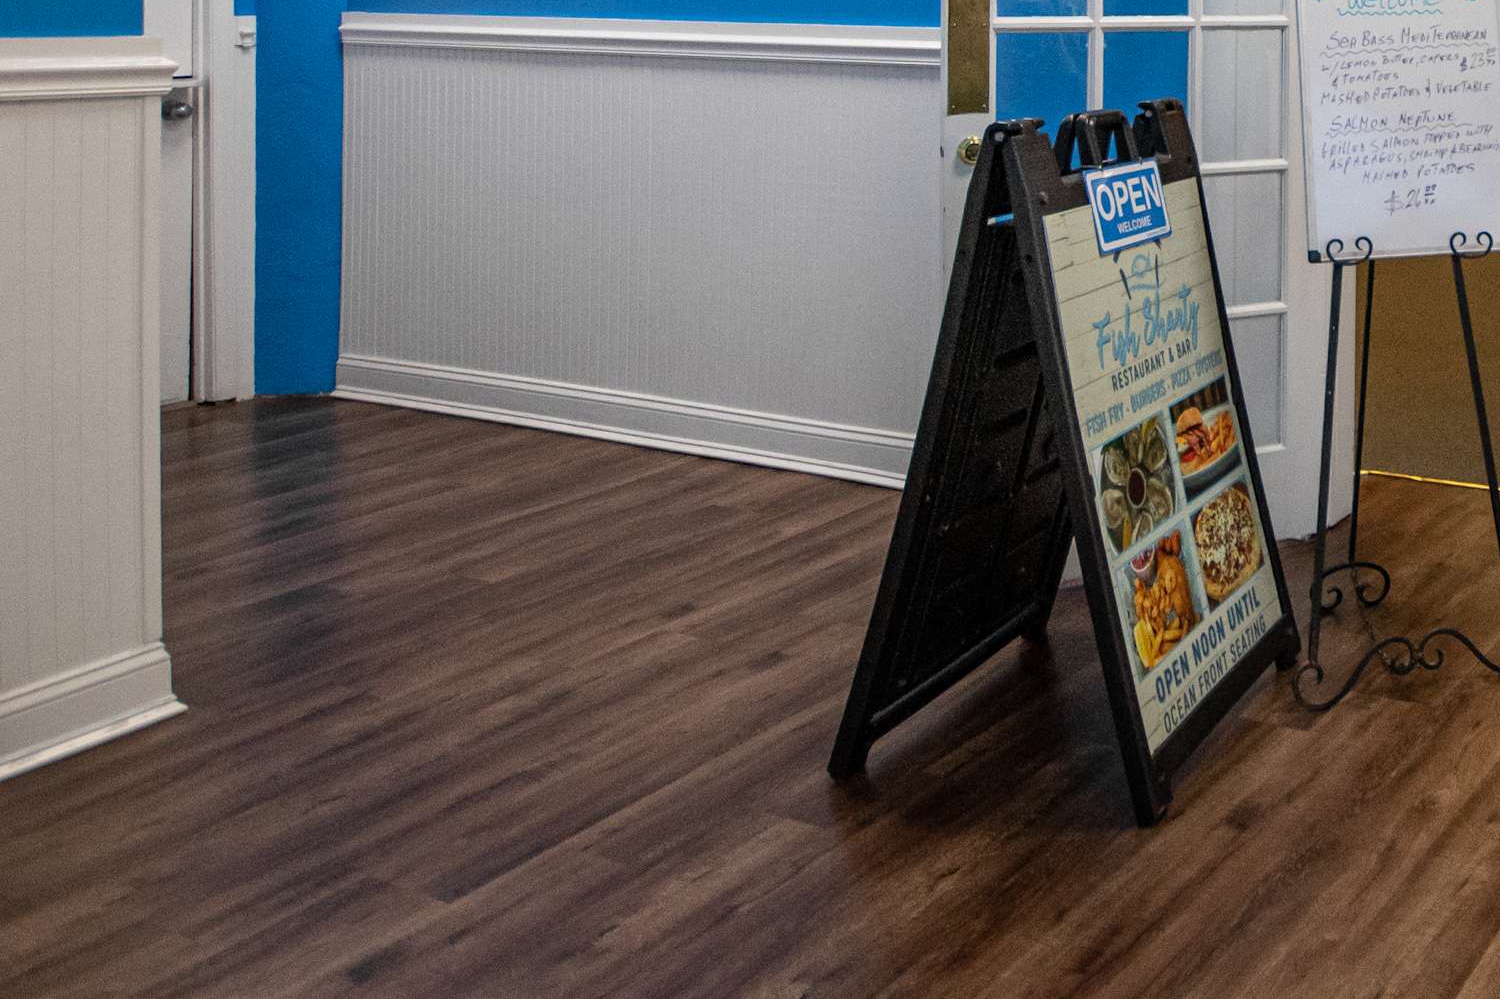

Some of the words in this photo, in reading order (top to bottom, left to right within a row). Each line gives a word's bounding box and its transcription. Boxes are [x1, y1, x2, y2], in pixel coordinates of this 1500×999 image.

[1330, 114, 1388, 132] SALMON
[1096, 173, 1163, 221] OPEN
[1117, 215, 1153, 235] WELCOME
[1092, 311, 1142, 372] Fish
[1142, 283, 1201, 352] Shanty
[1111, 351, 1166, 392] RESTAURANT
[1168, 347, 1175, 362] &
[1176, 338, 1192, 359] BAR
[1086, 410, 1107, 438] FISH
[1108, 401, 1124, 425] FRY
[1130, 379, 1168, 414] BURGERS
[1171, 365, 1191, 390] PIZZA
[1155, 650, 1191, 703] OPEN
[1191, 617, 1226, 668] NOON
[1226, 586, 1261, 632] UNTIL
[1163, 684, 1197, 734] OCEAN
[1198, 650, 1229, 696] FRONT
[1230, 614, 1267, 663] SEATING
